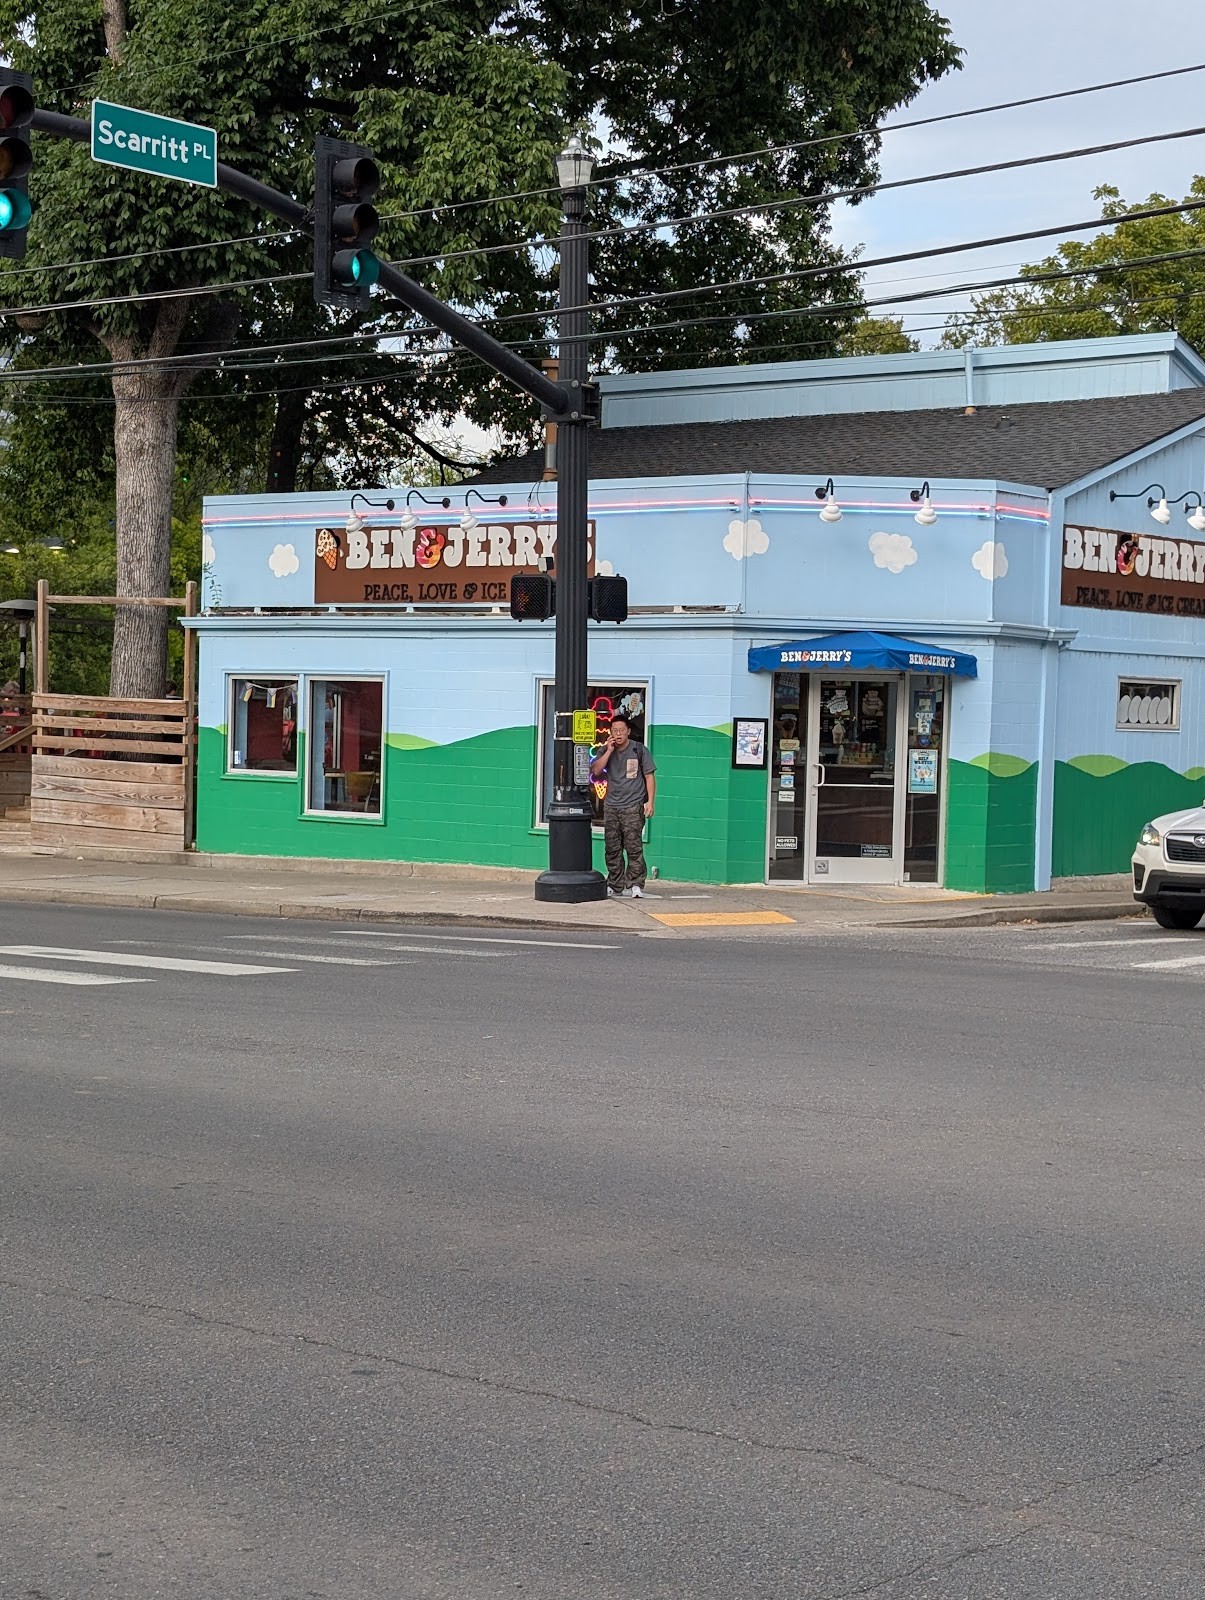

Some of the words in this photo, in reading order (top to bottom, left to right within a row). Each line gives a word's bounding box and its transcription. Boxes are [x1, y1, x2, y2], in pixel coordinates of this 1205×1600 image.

[98, 120, 189, 163] Scarritt
[193, 142, 211, 160] PL
[364, 583, 413, 602] PEACE,
[418, 582, 457, 600] LOVE
[463, 582, 477, 600] &
[481, 582, 506, 600] ICE
[1116, 589, 1143, 610] LOVE
[1177, 596, 1205, 616] CREA
[915, 711, 934, 720] OPEN
